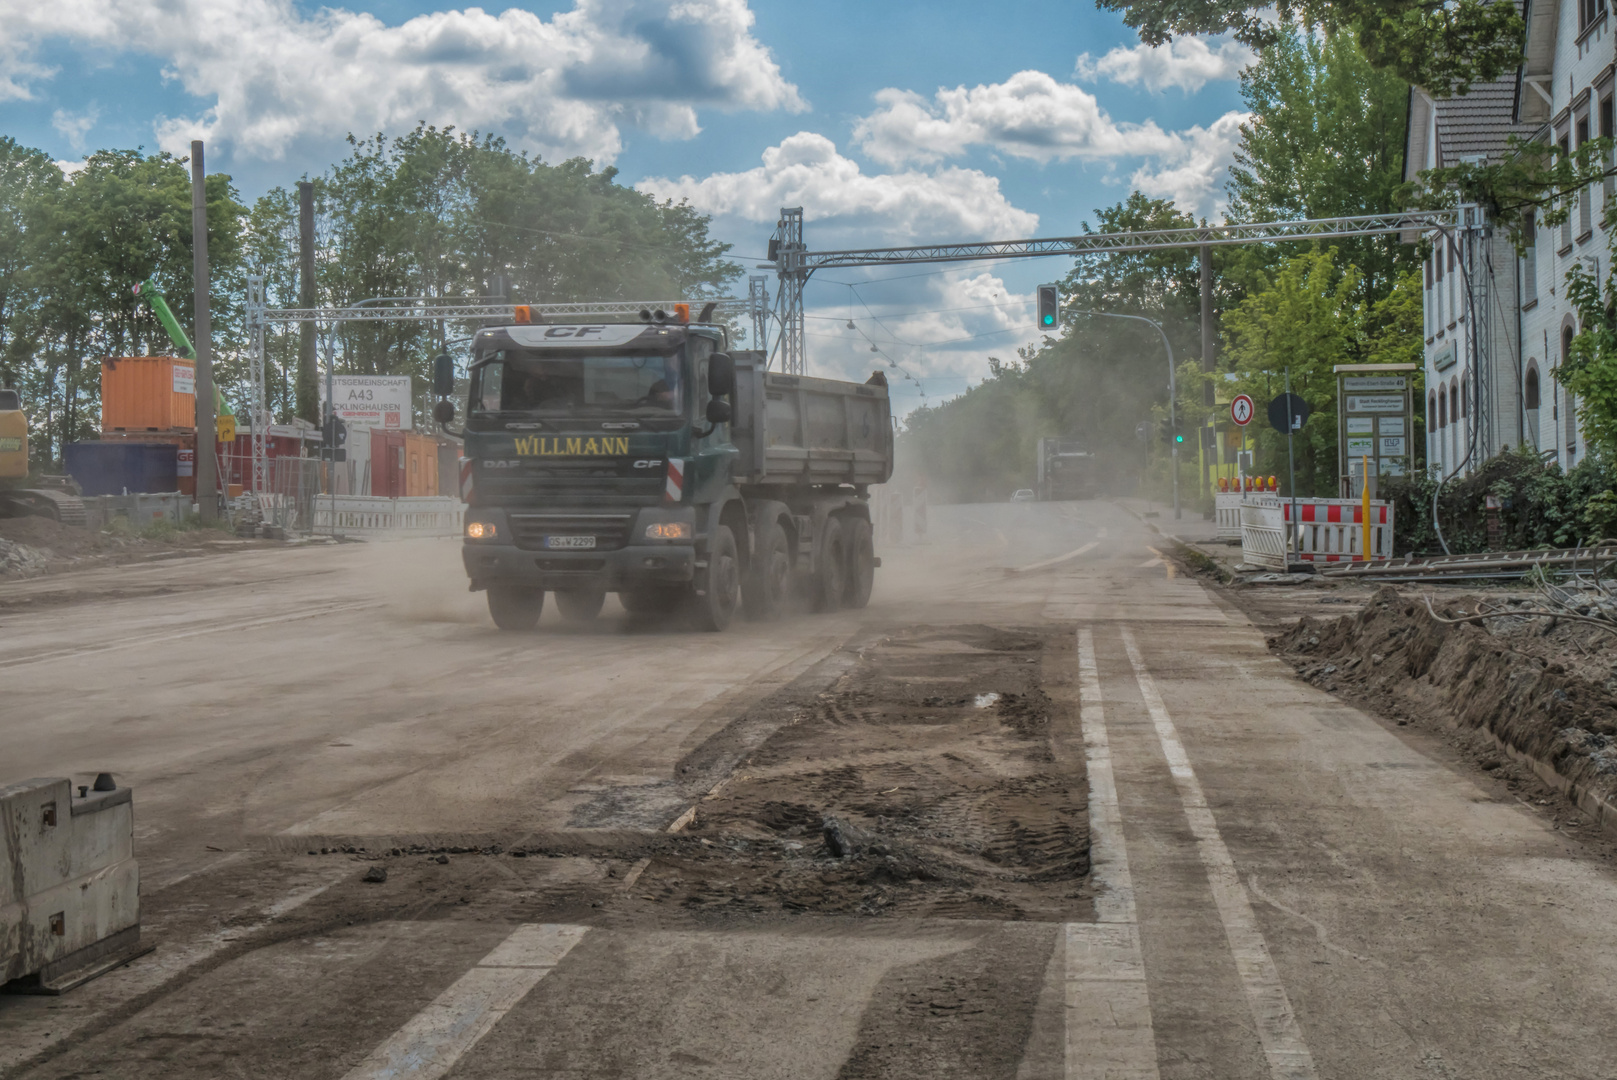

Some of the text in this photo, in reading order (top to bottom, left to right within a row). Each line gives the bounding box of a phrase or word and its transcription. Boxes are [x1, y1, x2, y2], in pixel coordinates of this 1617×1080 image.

[544, 326, 606, 338] CF
[348, 389, 374, 401] A43
[334, 403, 400, 411] CKLINGHAUSEN
[514, 435, 630, 456] WILLMANN
[483, 460, 520, 468] DAF
[633, 460, 662, 468] CF
